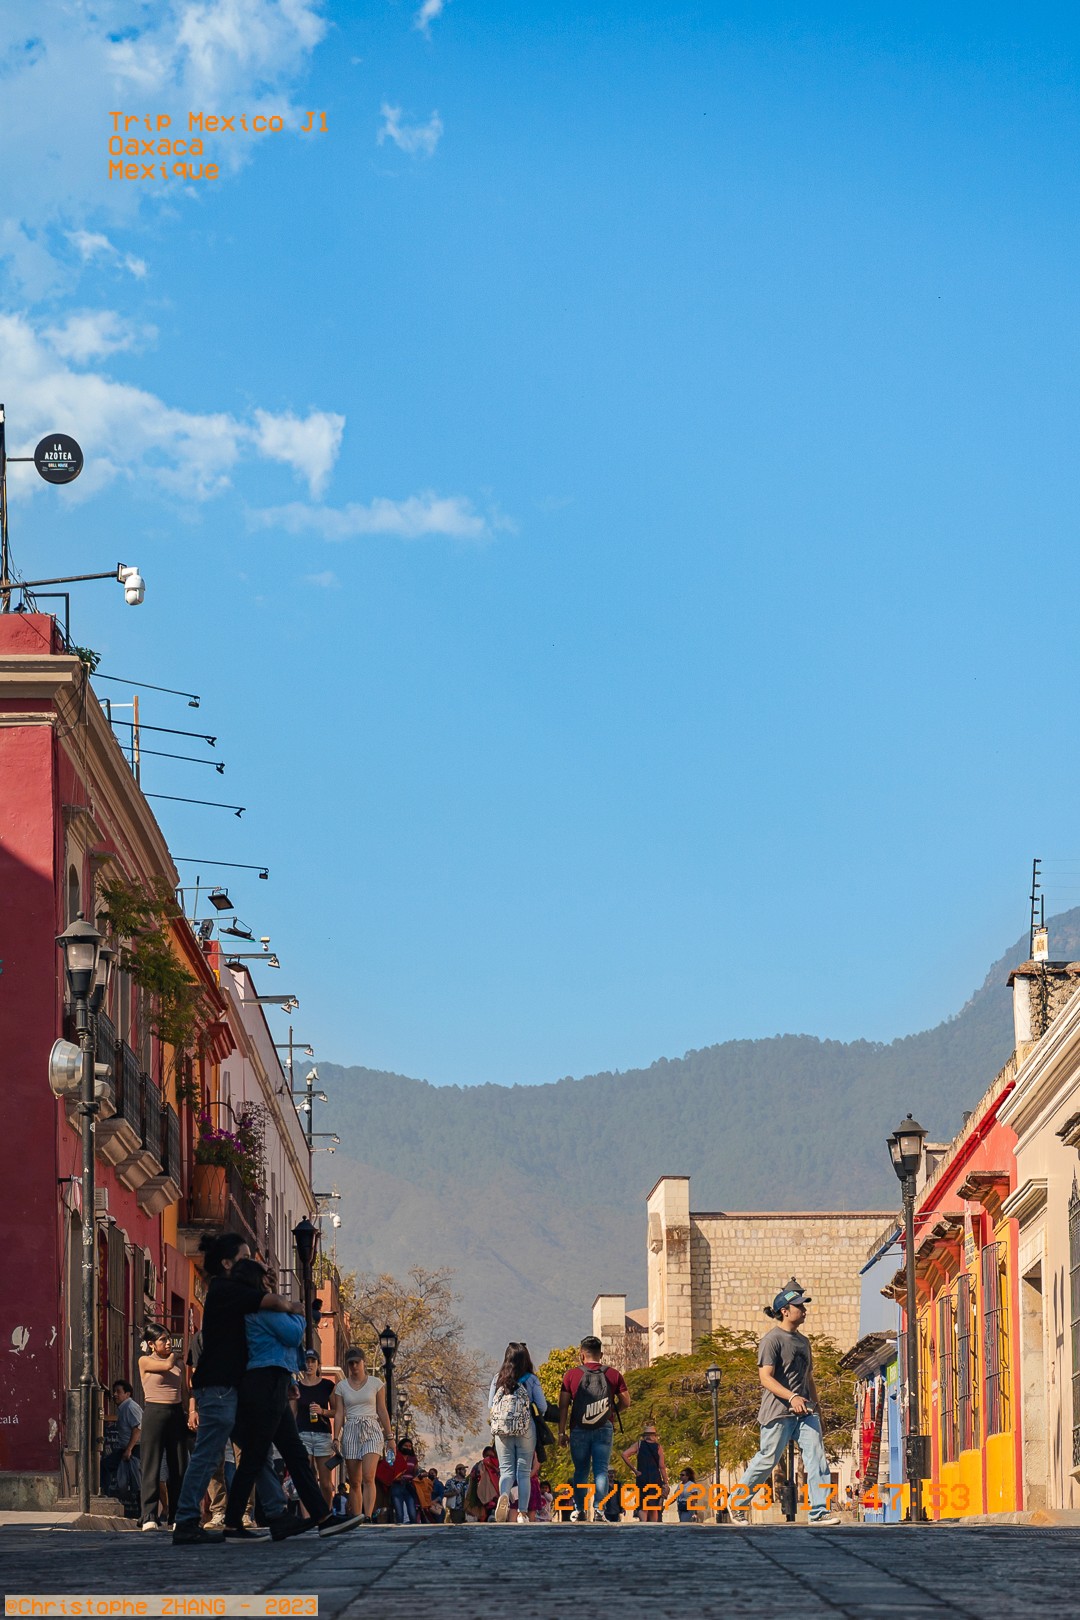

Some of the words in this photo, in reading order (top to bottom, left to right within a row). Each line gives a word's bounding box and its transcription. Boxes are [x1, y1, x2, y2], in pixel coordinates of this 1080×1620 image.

[53, 443, 62, 451] LA
[44, 451, 72, 460] AZOTEA
[585, 1396, 609, 1418] NIKE
